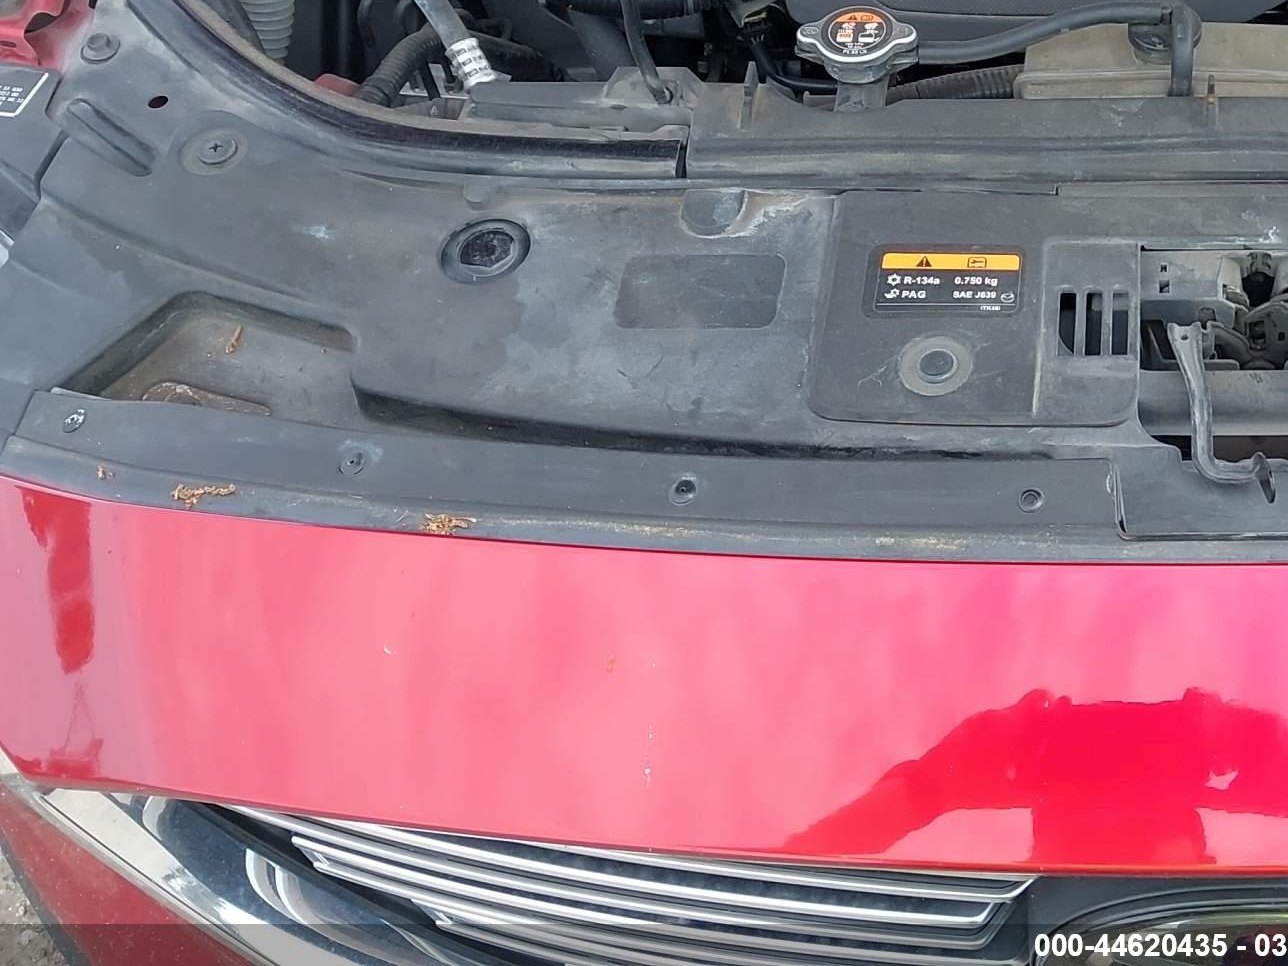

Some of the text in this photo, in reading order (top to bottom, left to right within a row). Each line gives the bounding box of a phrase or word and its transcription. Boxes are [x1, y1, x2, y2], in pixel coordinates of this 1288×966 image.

[903, 276, 998, 286] R-134a 0.750 kg
[901, 290, 997, 299] PAG SAE J639
